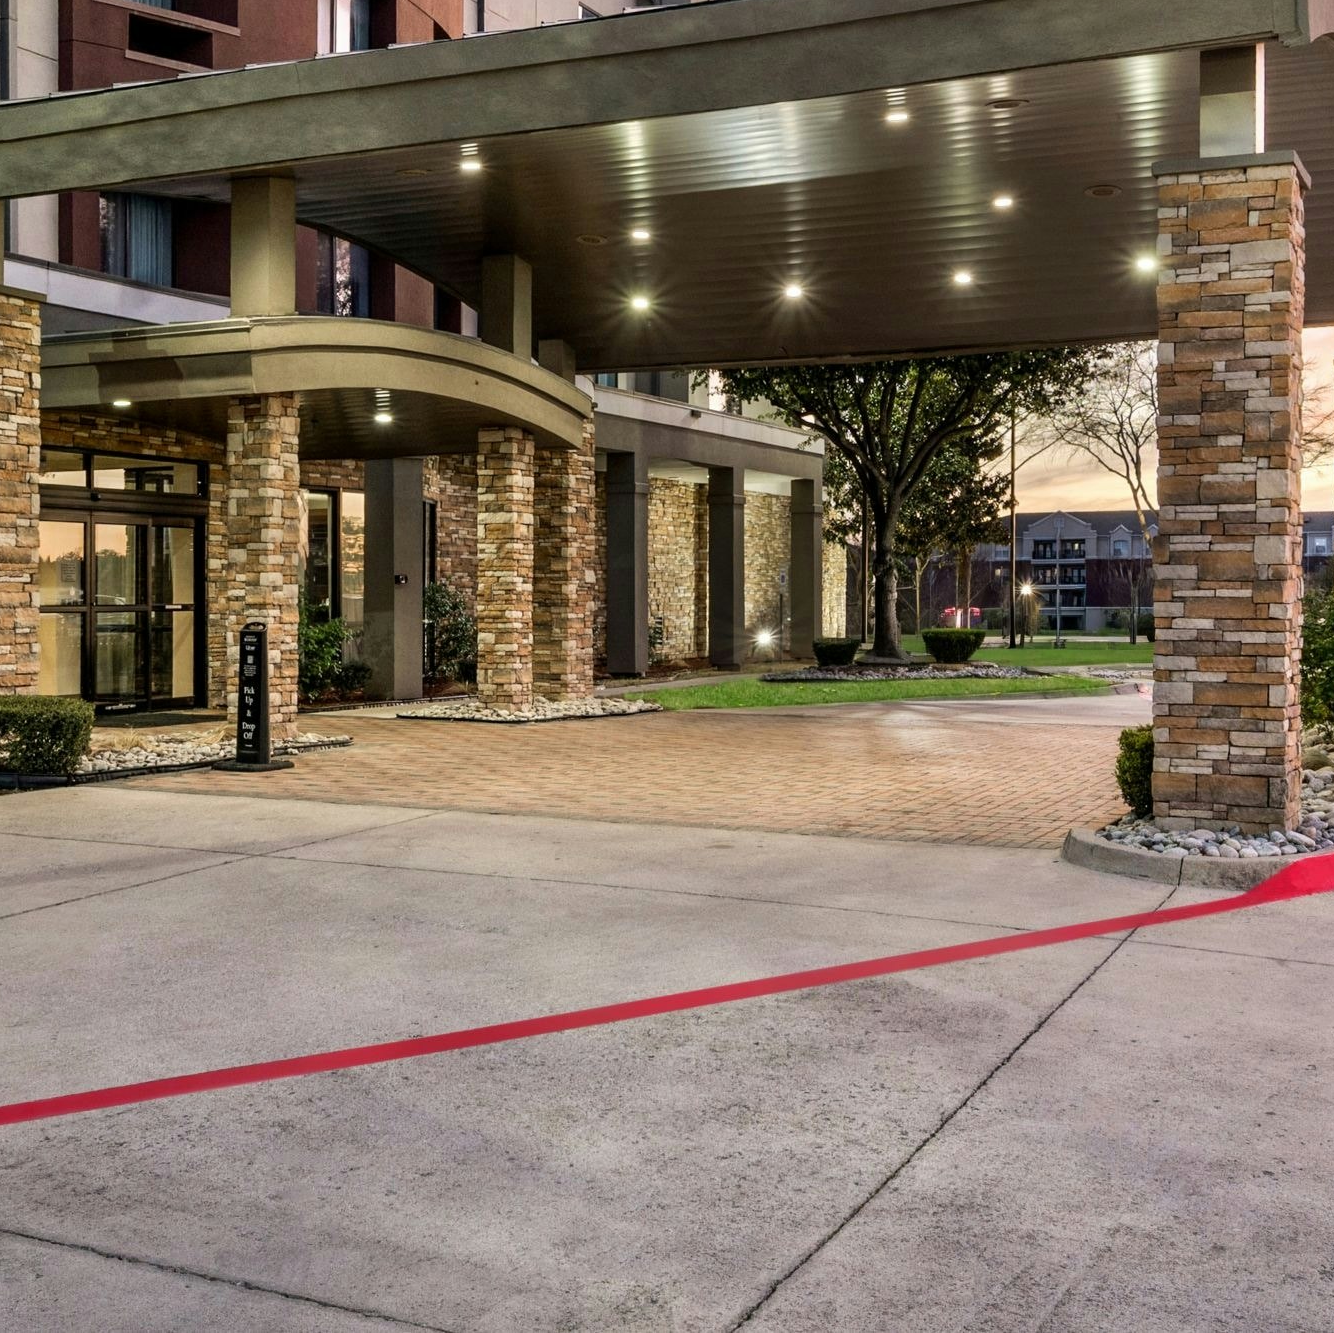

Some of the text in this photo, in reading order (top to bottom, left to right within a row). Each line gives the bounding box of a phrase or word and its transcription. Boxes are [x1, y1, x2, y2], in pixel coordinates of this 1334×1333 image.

[244, 686, 255, 694] Pick
[245, 695, 254, 706] Up
[242, 721, 256, 732] Drop
[243, 732, 253, 740] Off
